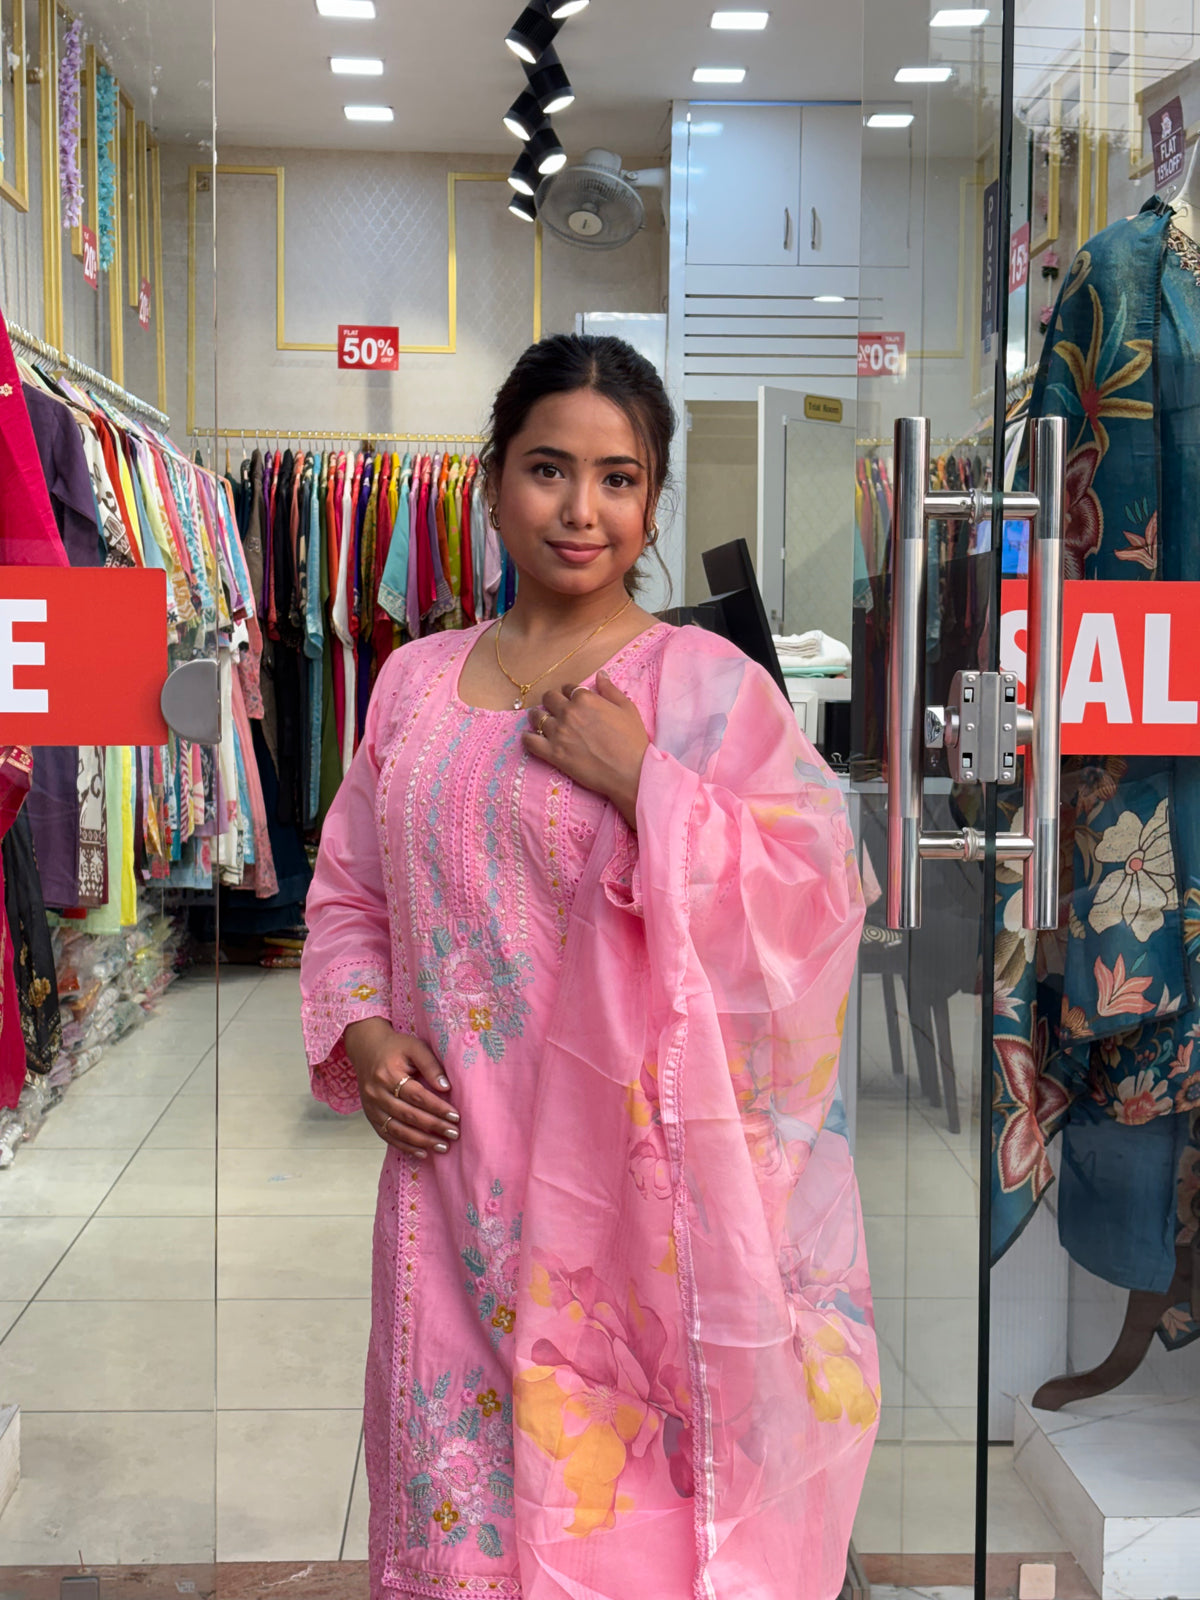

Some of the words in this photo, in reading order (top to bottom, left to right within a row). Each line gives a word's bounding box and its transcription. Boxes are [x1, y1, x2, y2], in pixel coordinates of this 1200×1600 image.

[1161, 136, 1177, 161] FLAT
[343, 338, 394, 364] 50%
[0, 599, 49, 713] E
